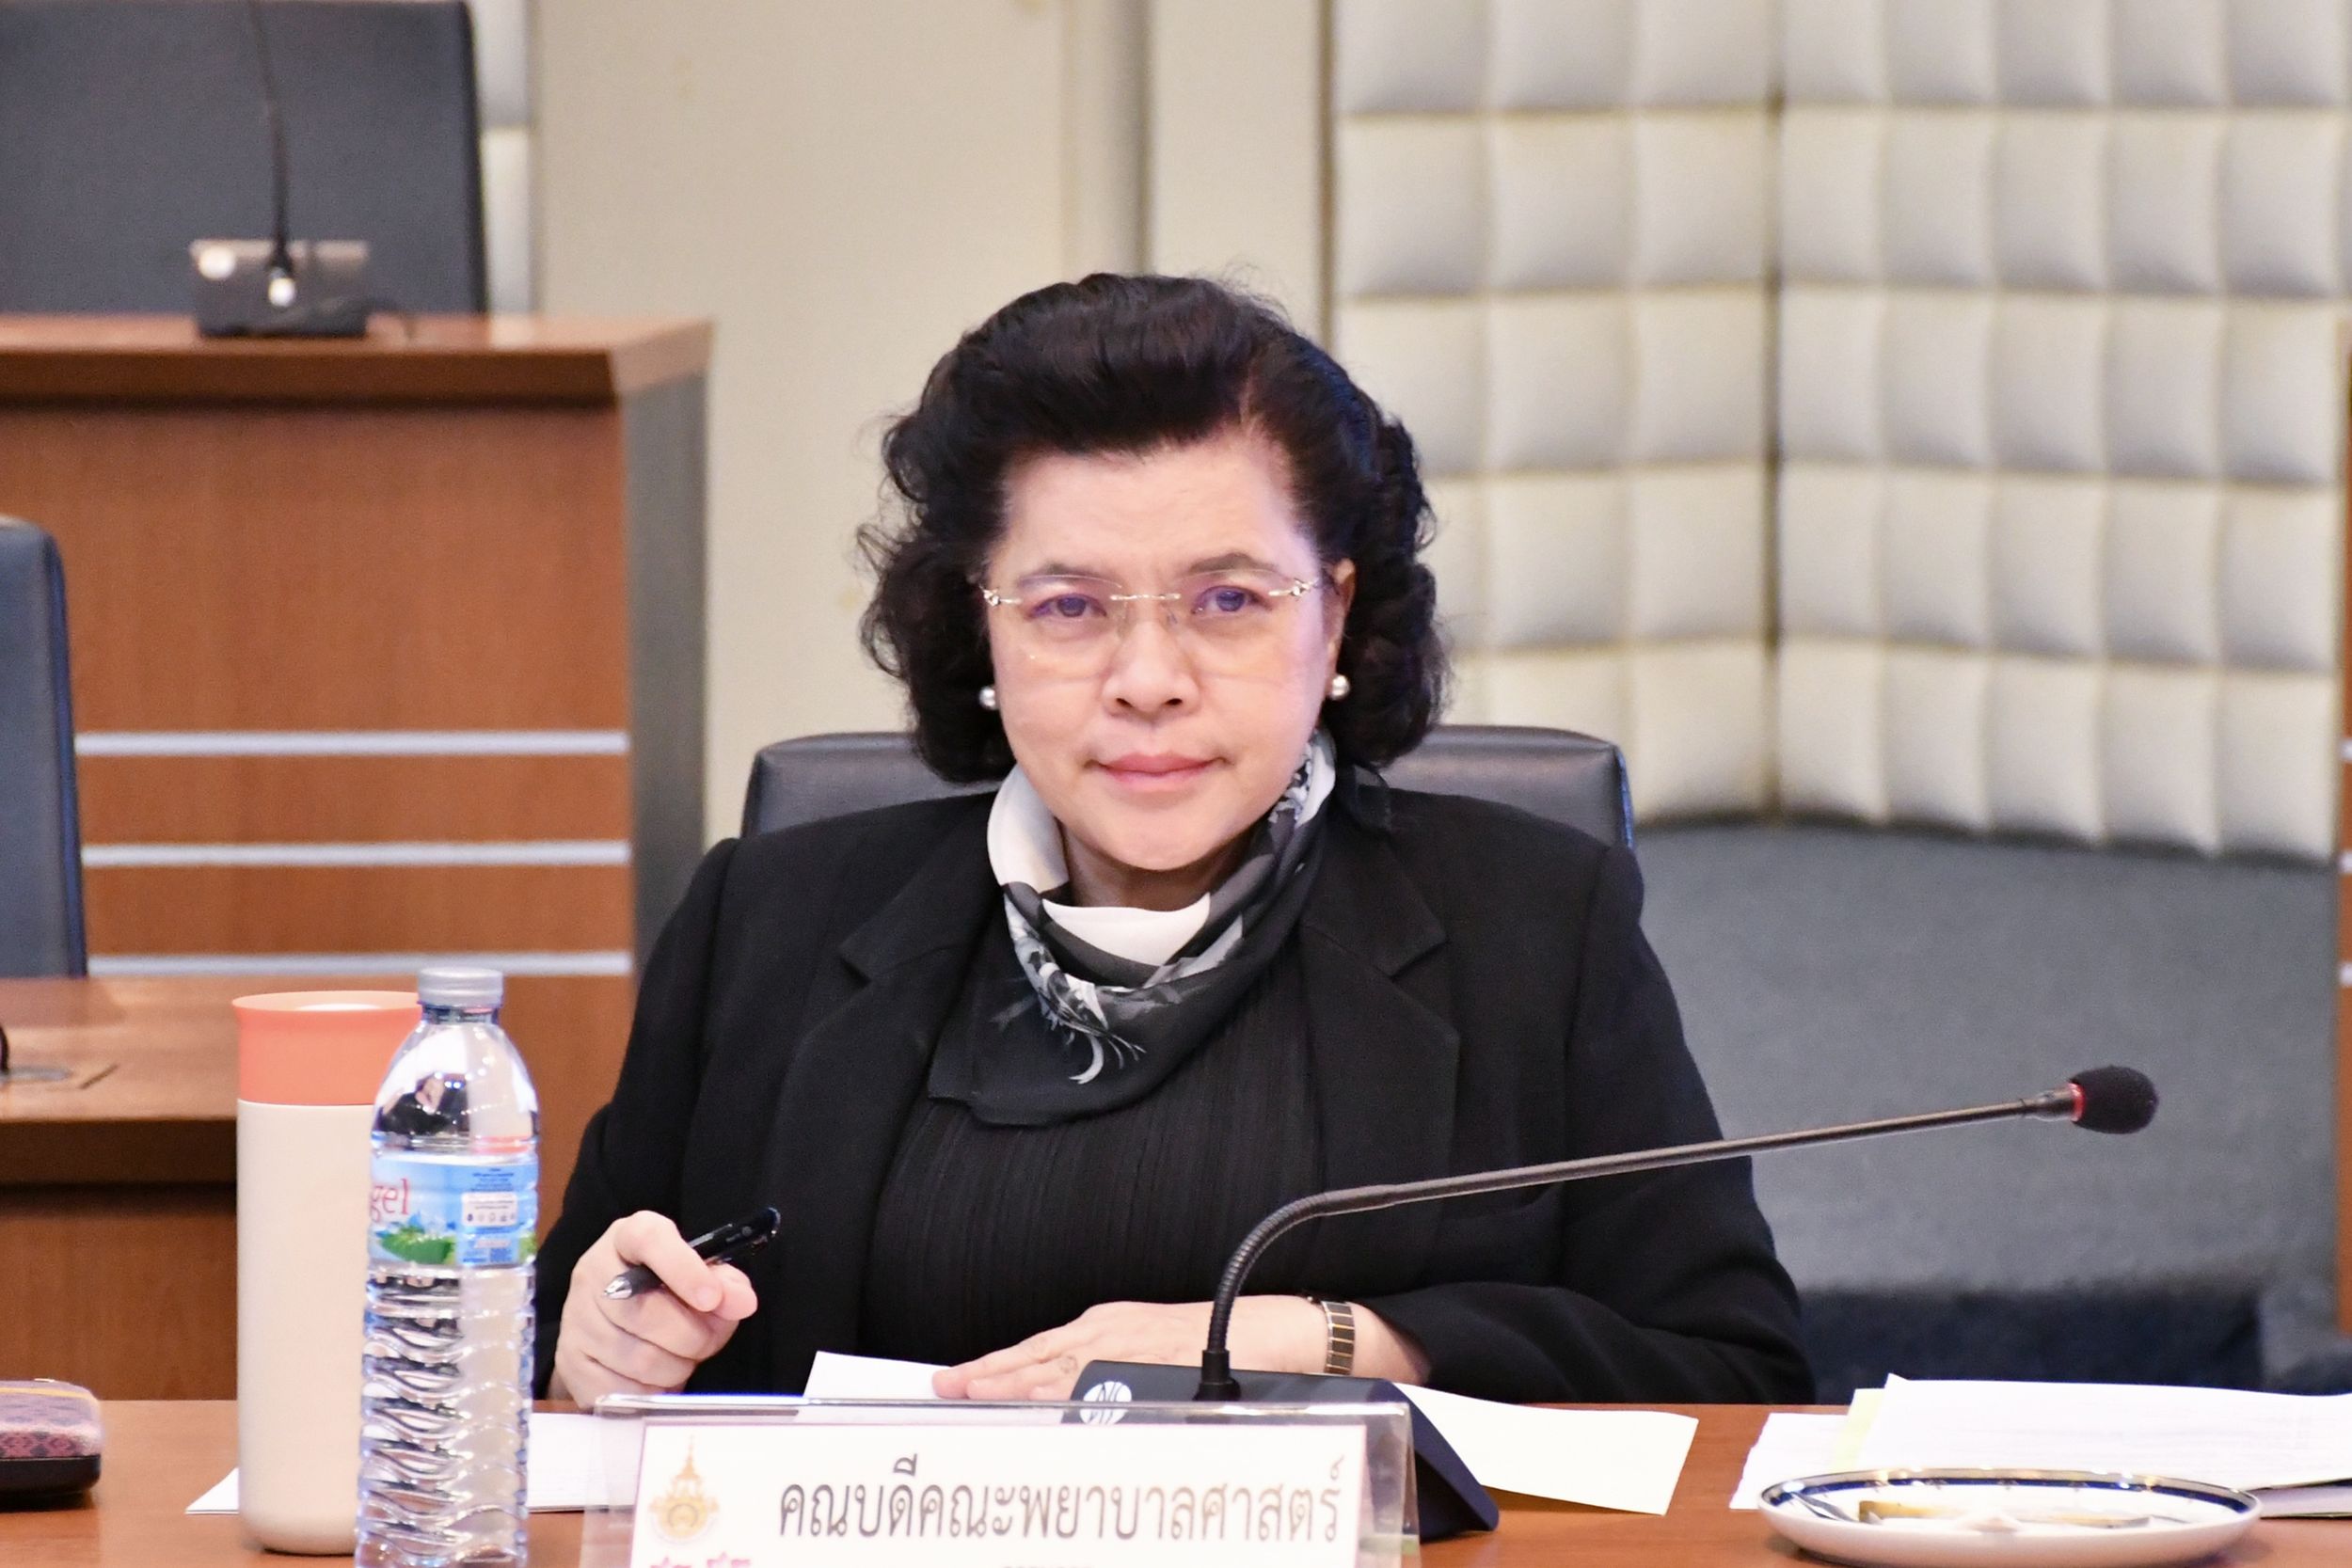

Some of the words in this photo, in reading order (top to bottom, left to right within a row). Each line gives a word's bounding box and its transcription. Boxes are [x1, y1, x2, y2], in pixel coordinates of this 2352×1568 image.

[779, 1453, 1345, 1543] คณบดีคณะพยาบาลศาสตร์
